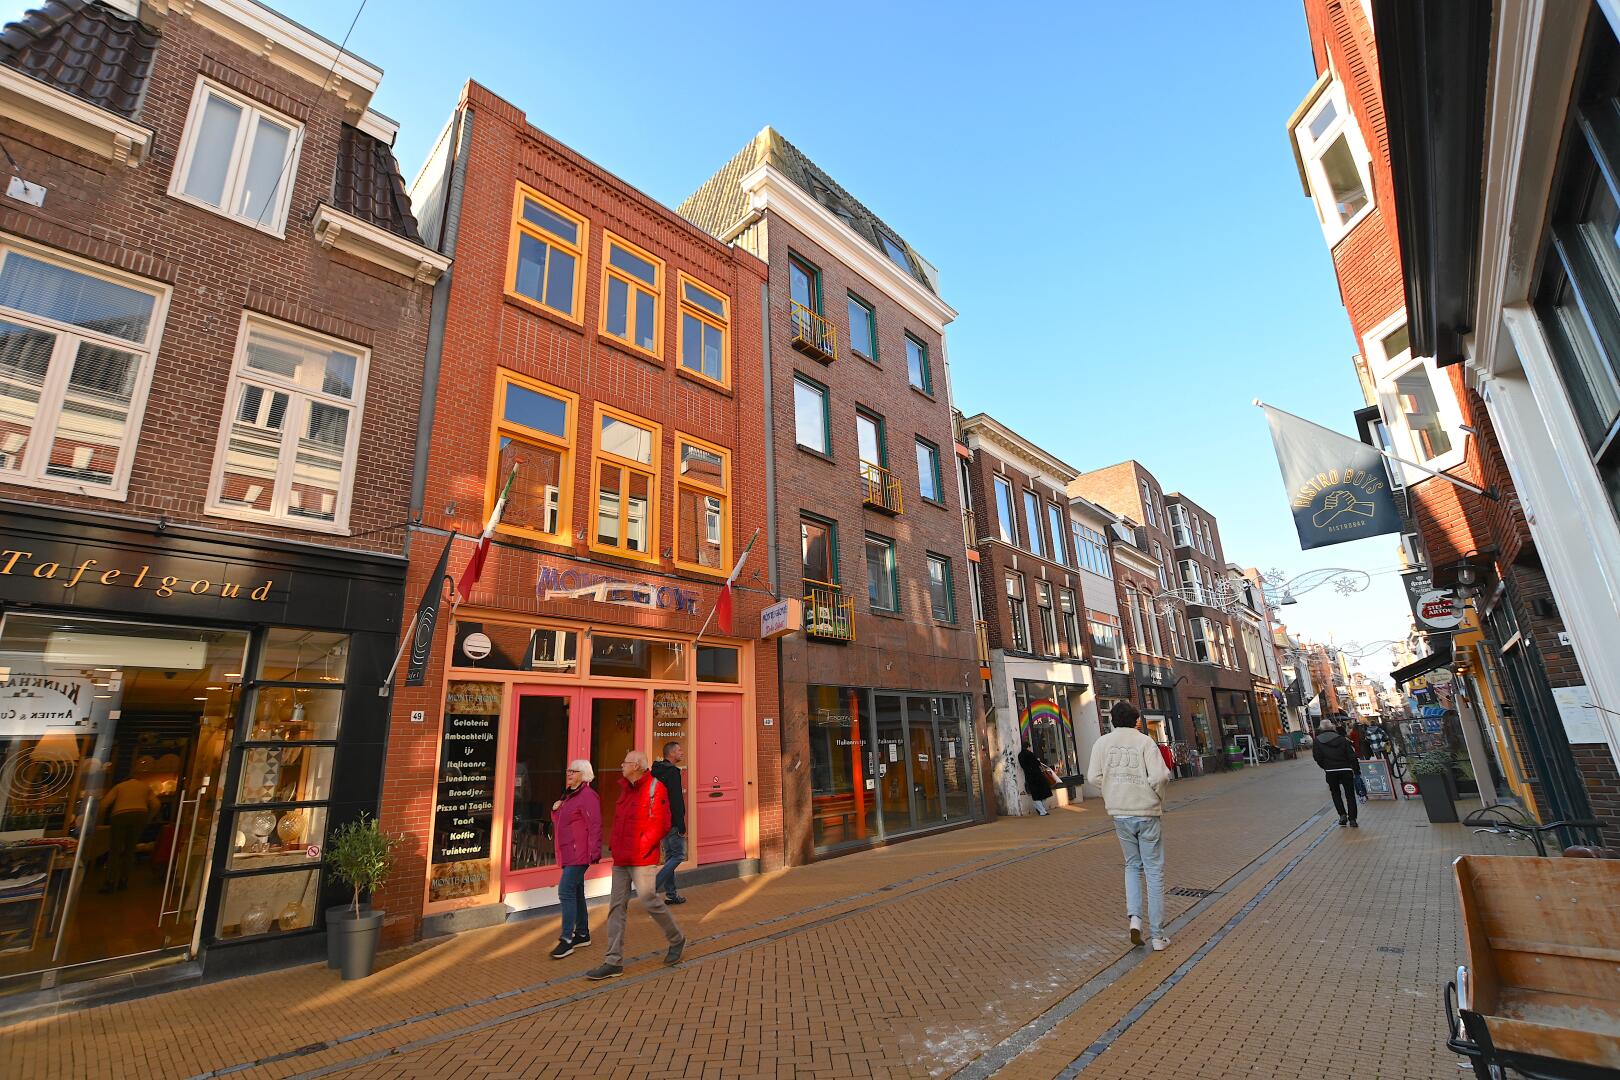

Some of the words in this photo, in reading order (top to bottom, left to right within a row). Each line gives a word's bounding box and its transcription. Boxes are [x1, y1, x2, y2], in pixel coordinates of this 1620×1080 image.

[1294, 468, 1339, 507] BISTRO
[1343, 468, 1384, 494] BOYS
[0, 549, 273, 601] Tafelgoud
[413, 712, 422, 720] 49
[453, 719, 489, 727] Gelateria
[444, 732, 494, 741] Ambachtelijk
[464, 746, 474, 755] ijs
[447, 760, 486, 768] Italiaanse
[448, 788, 483, 798] Broodjes
[436, 804, 458, 812] Pizza
[459, 803, 467, 811] al
[468, 801, 492, 811] Taglio
[452, 816, 475, 826] Taart
[449, 832, 475, 841] Koffie
[441, 844, 482, 857] Tuinterras
